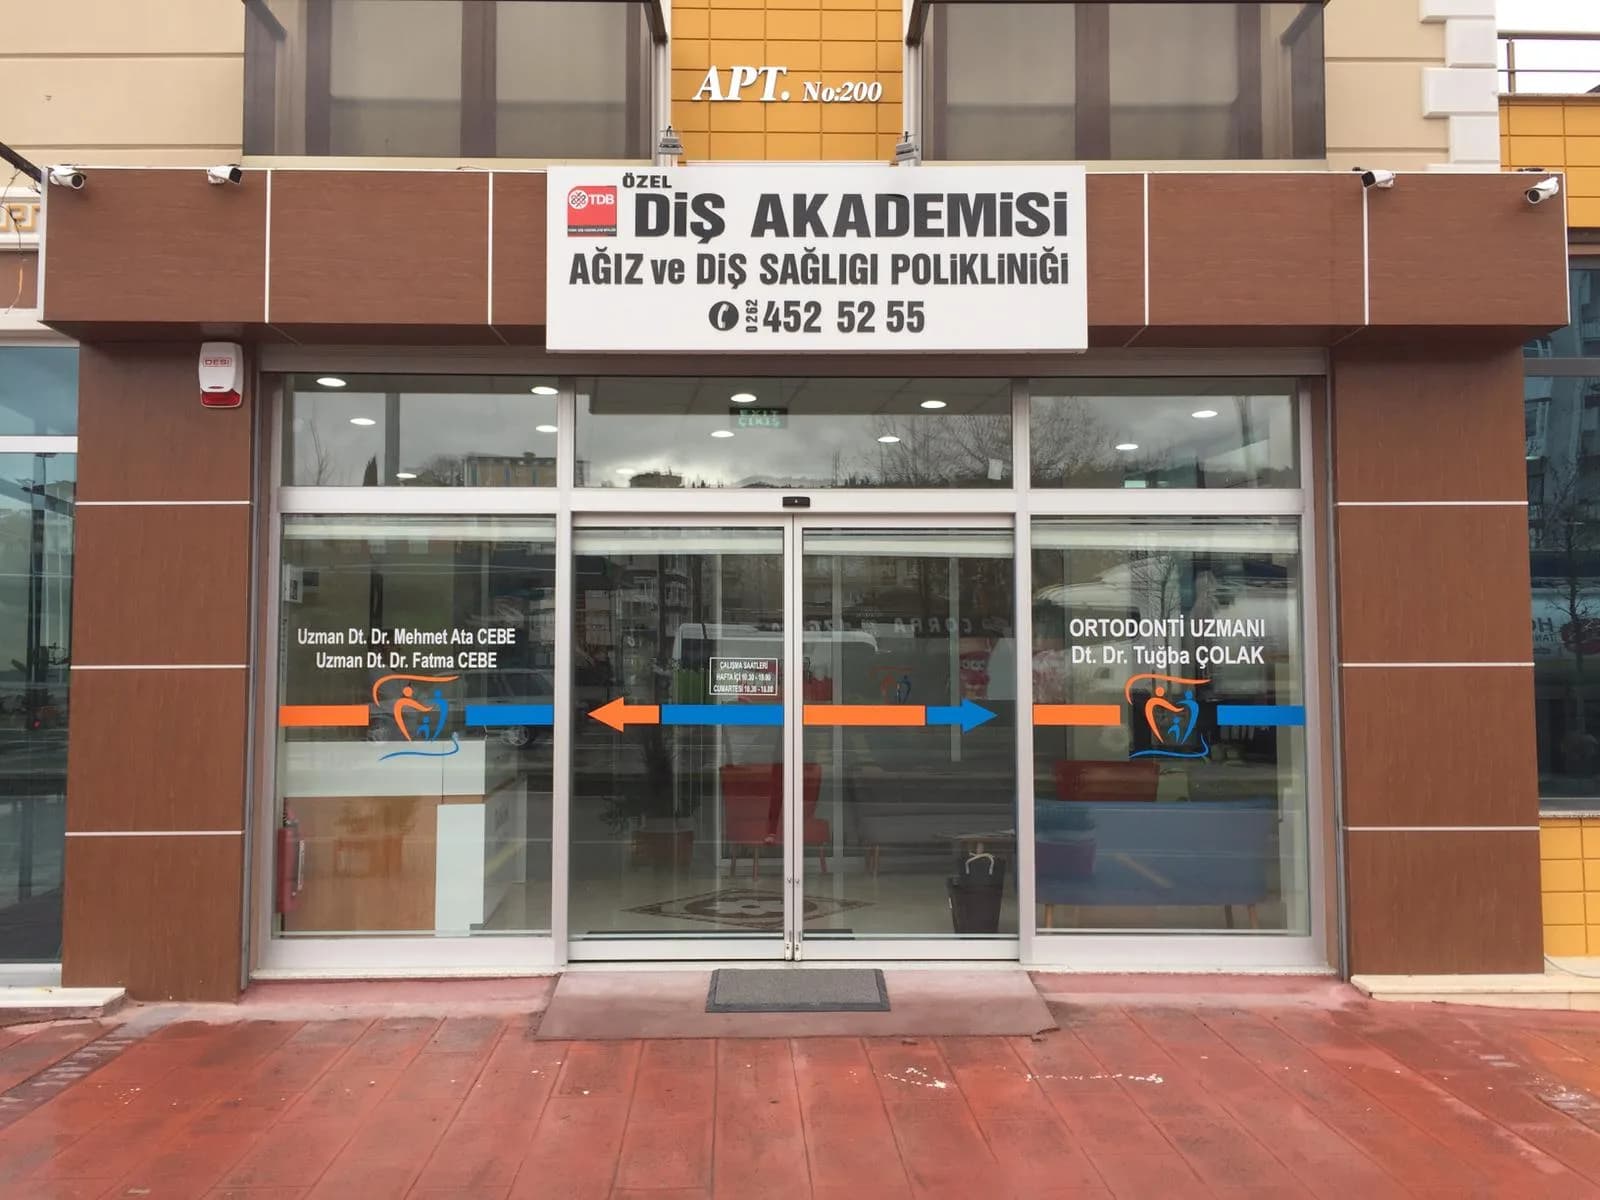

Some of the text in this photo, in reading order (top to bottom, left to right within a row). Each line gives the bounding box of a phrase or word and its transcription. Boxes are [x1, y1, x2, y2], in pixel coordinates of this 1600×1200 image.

[692, 65, 882, 102] APT. No:200
[622, 172, 672, 189] ÖZEL
[588, 193, 615, 205] TDB
[569, 246, 644, 285] AĞIZ
[651, 258, 685, 285] ve
[745, 299, 925, 333] 0262 452 52 55
[297, 628, 516, 645] Uzman Dt. Dr. Mehmet Ata CEBE
[1069, 615, 1265, 638] ORTODONTİ UZMANI
[316, 652, 497, 669] Uzman Dt. Dr. Fatma CEBE
[1071, 646, 1264, 668] Dt. Dr. Tuğba ÇOLAK
